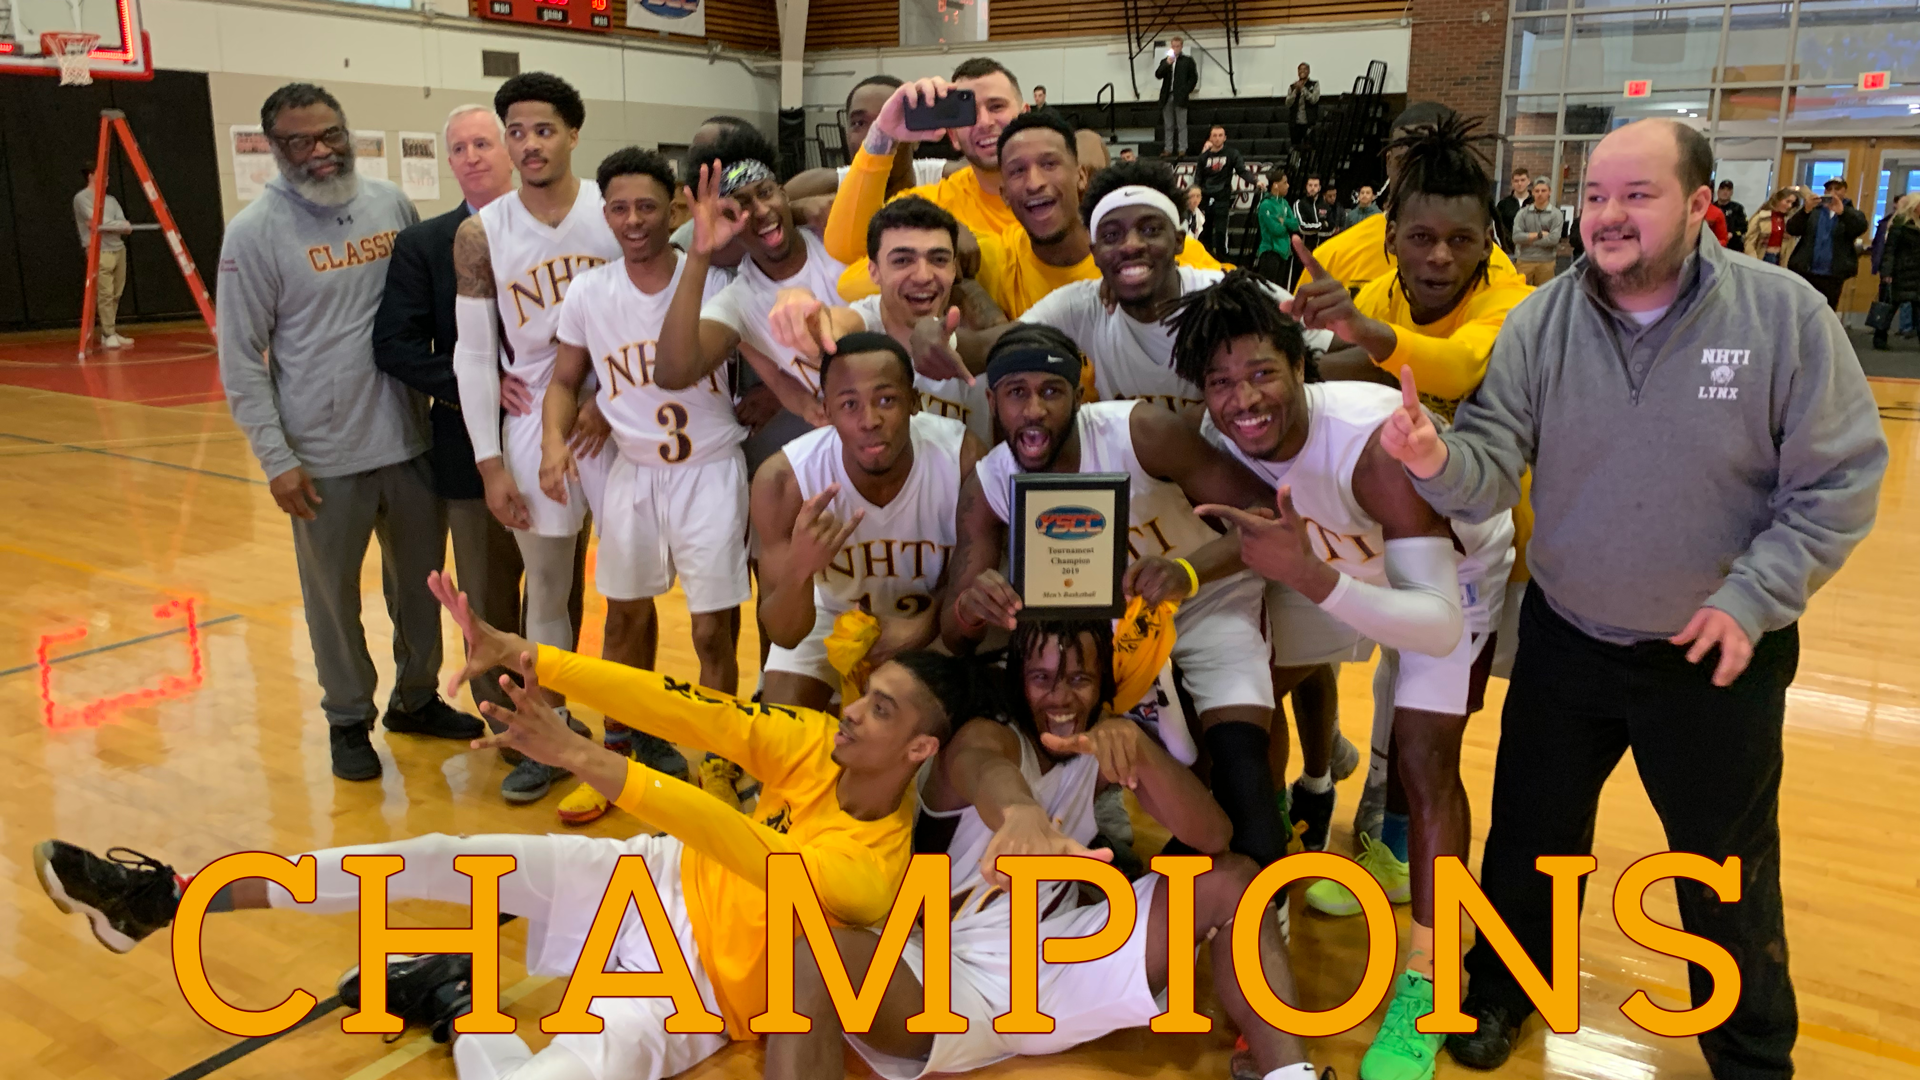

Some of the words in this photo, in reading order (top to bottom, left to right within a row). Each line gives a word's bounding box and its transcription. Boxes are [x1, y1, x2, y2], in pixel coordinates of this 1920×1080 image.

[307, 229, 398, 272] CLASSI
[507, 254, 608, 328] NH
[1701, 348, 1751, 365] NHTI
[1698, 386, 1739, 399] LYNX
[655, 402, 692, 464] 3
[1038, 513, 1104, 534] YSCC
[1048, 546, 1095, 554] Tournament
[1050, 557, 1091, 566] Champion
[1061, 567, 1080, 575] 2019
